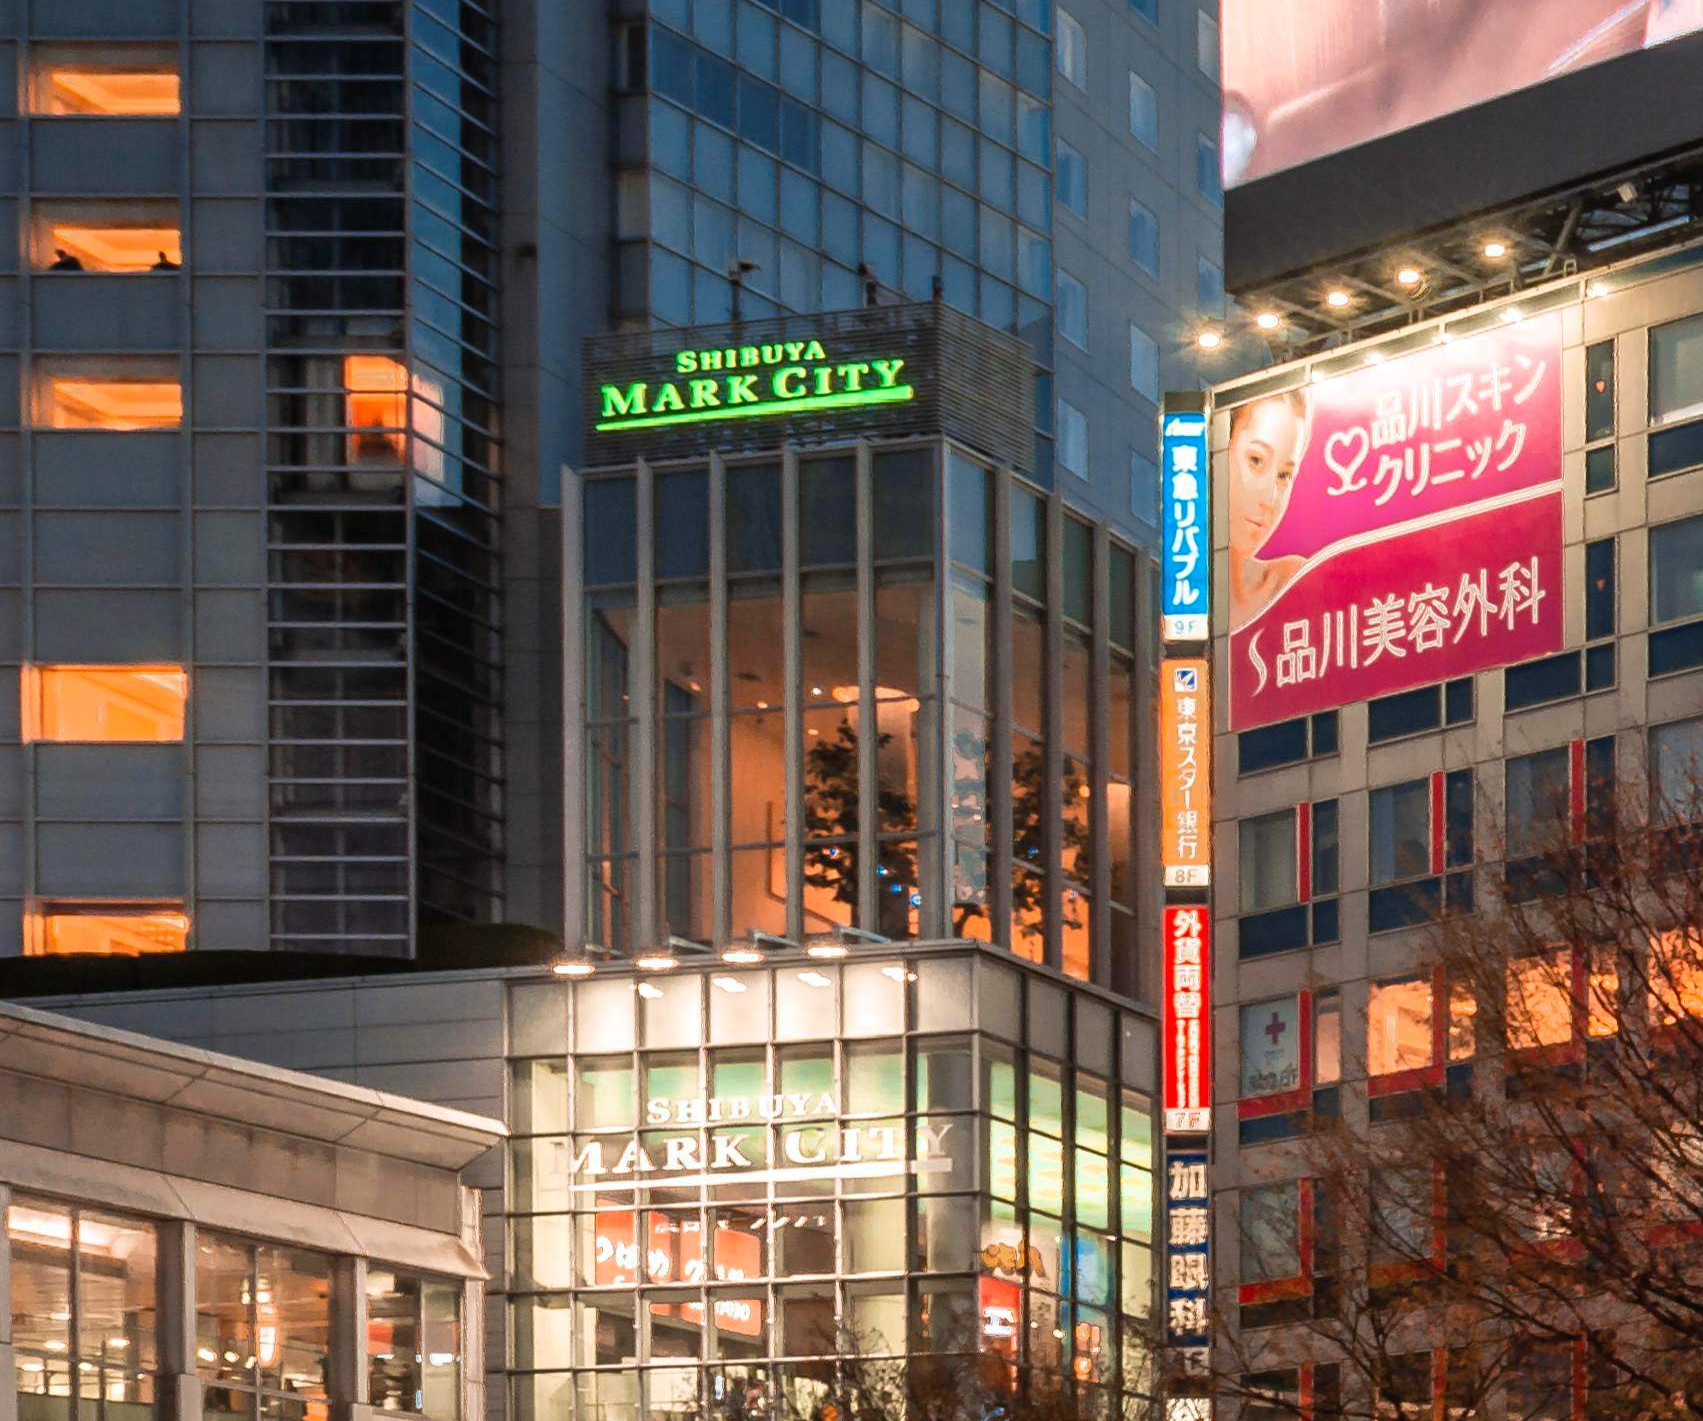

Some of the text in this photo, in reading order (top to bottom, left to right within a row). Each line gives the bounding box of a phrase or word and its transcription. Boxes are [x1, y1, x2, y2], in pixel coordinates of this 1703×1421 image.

[600, 358, 905, 418] MARK CITY
[675, 339, 827, 374] SHIBUYA
[1369, 353, 1547, 449] 品川スキン
[1373, 419, 1529, 507] クリニック
[1171, 443, 1200, 607] 東急リバブル
[1174, 619, 1199, 636] 9F
[1276, 556, 1546, 688] 品川美容外科
[1176, 696, 1198, 860] 東京スター銀行
[645, 1090, 840, 1127] SHIBUYA
[568, 1123, 953, 1177] MARK CITY
